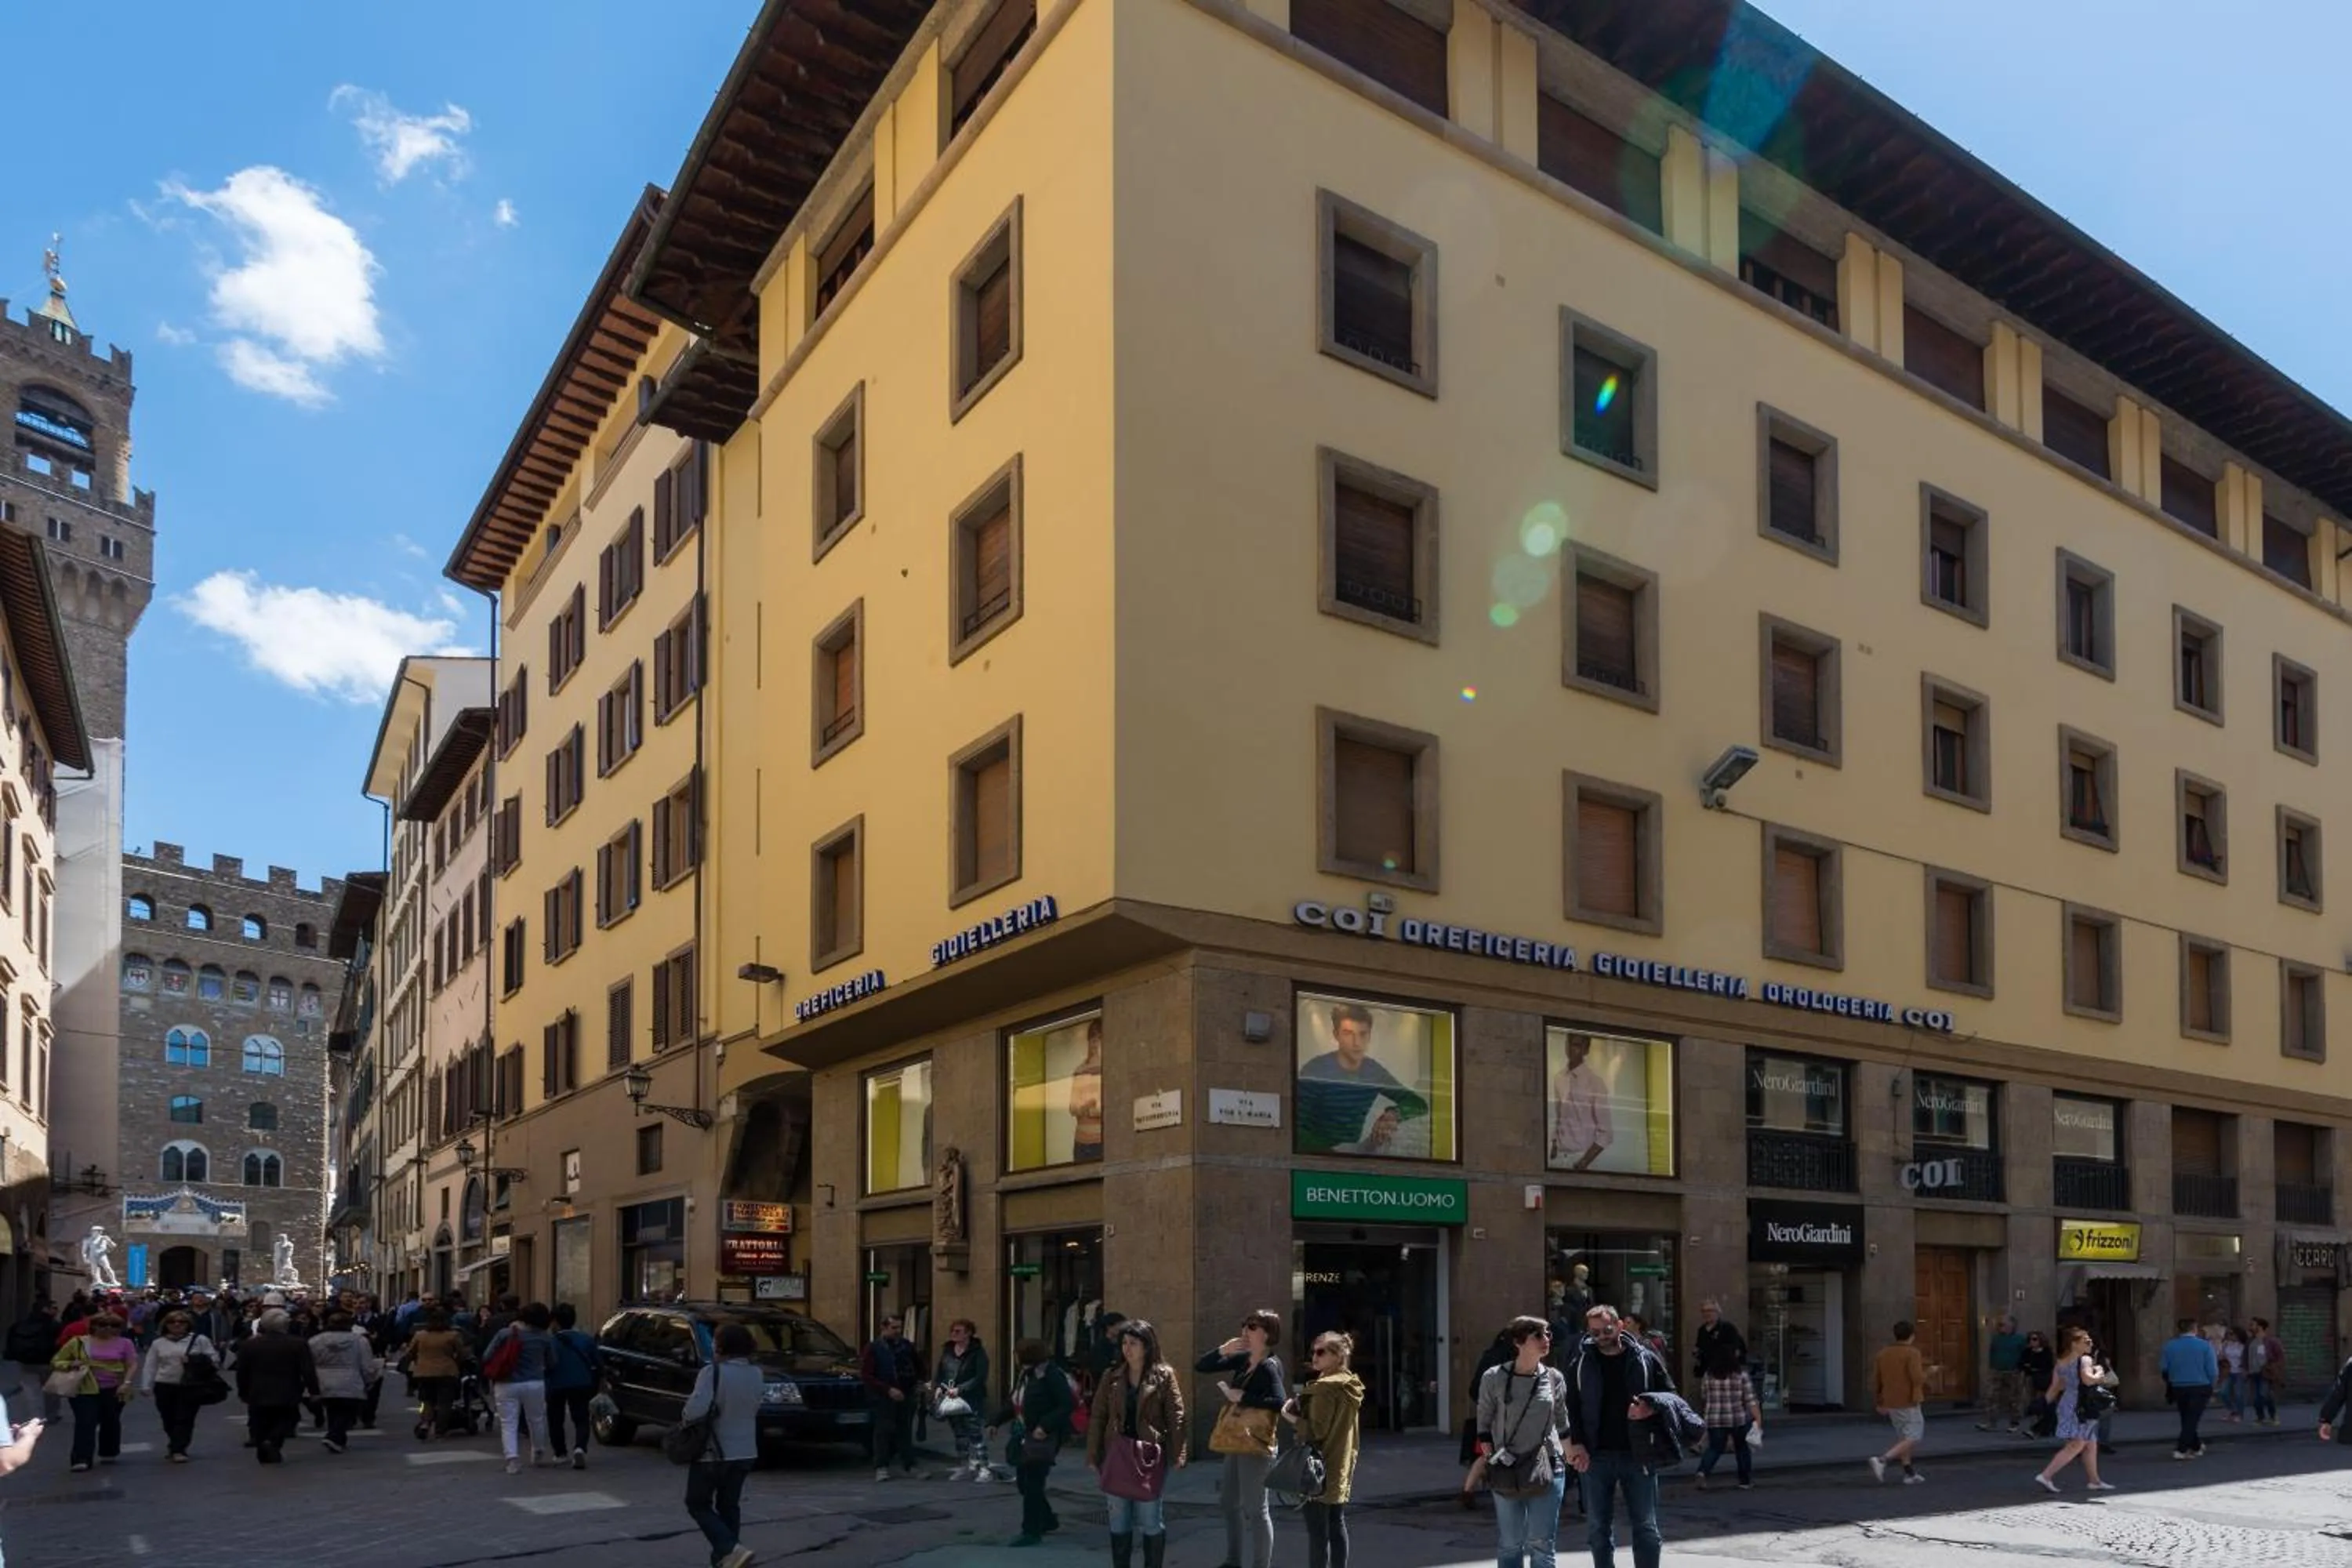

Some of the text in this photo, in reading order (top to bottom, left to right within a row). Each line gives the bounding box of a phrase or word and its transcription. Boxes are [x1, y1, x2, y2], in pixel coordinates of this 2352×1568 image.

[794, 895, 1058, 1019] OREFICERIA GIOIELLERIA
[1403, 919, 1578, 971] OREFICERIA
[1595, 952, 1750, 999] GIOIELLERIA
[1766, 982, 1895, 1022] OROLOGERIA
[1753, 1069, 1837, 1098] NeroGiardini
[1900, 1157, 1963, 1190] COI
[1306, 1186, 1456, 1208] BENETTON.UOMO
[1767, 1221, 1852, 1244] NeroGiardini
[2086, 1228, 2133, 1249] frizzoni
[724, 1239, 785, 1250] TRATTORIA
[1305, 1272, 1341, 1284] RENZE
